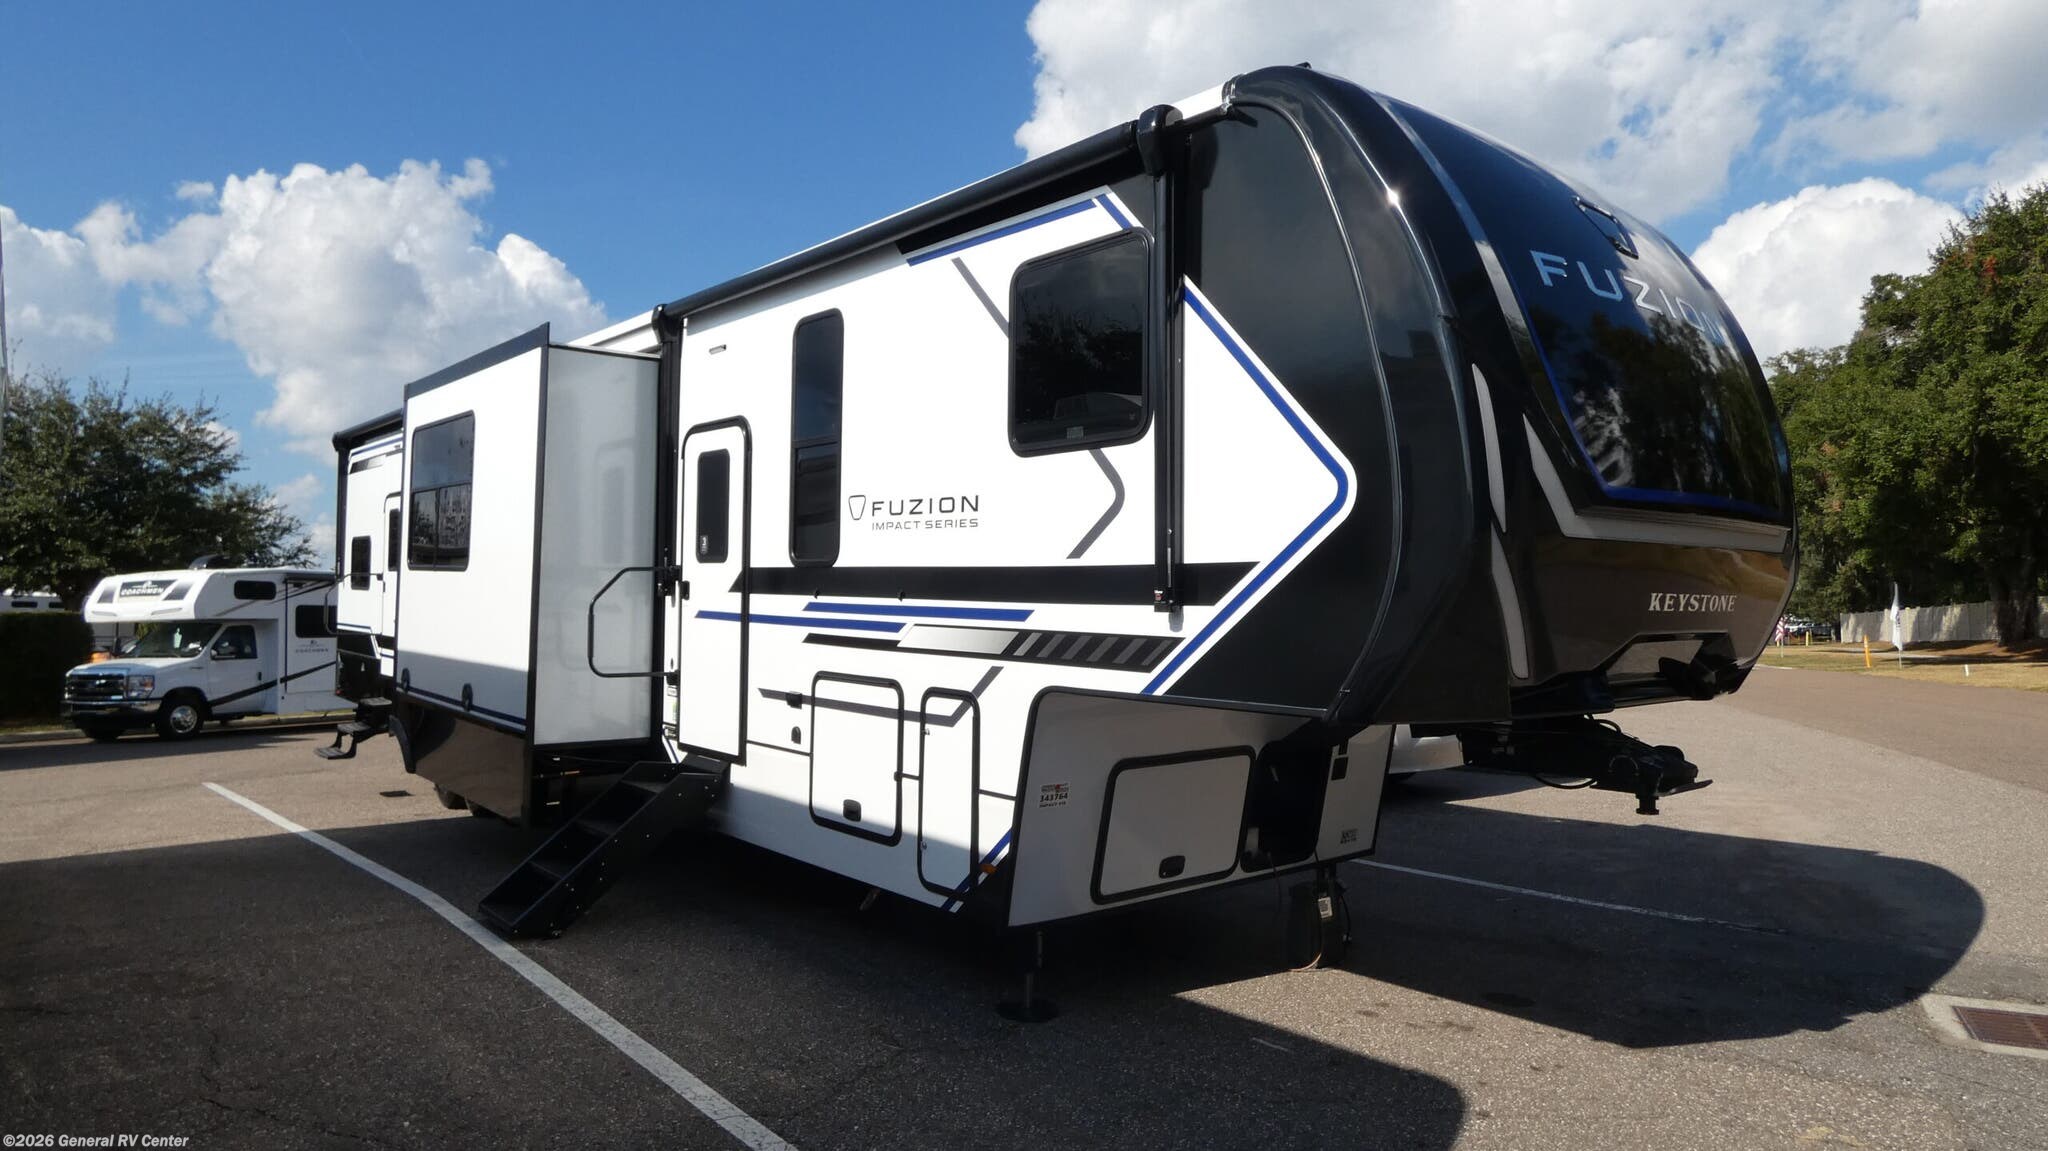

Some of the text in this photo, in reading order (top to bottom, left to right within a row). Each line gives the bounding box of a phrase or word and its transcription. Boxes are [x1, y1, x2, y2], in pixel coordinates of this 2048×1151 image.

[1529, 249, 1726, 345] FUZION
[871, 495, 979, 517] FUZION
[871, 518, 979, 531] IMPACT SERIES
[121, 587, 164, 596] COACHMEN
[1648, 592, 1737, 612] KEYSTONE
